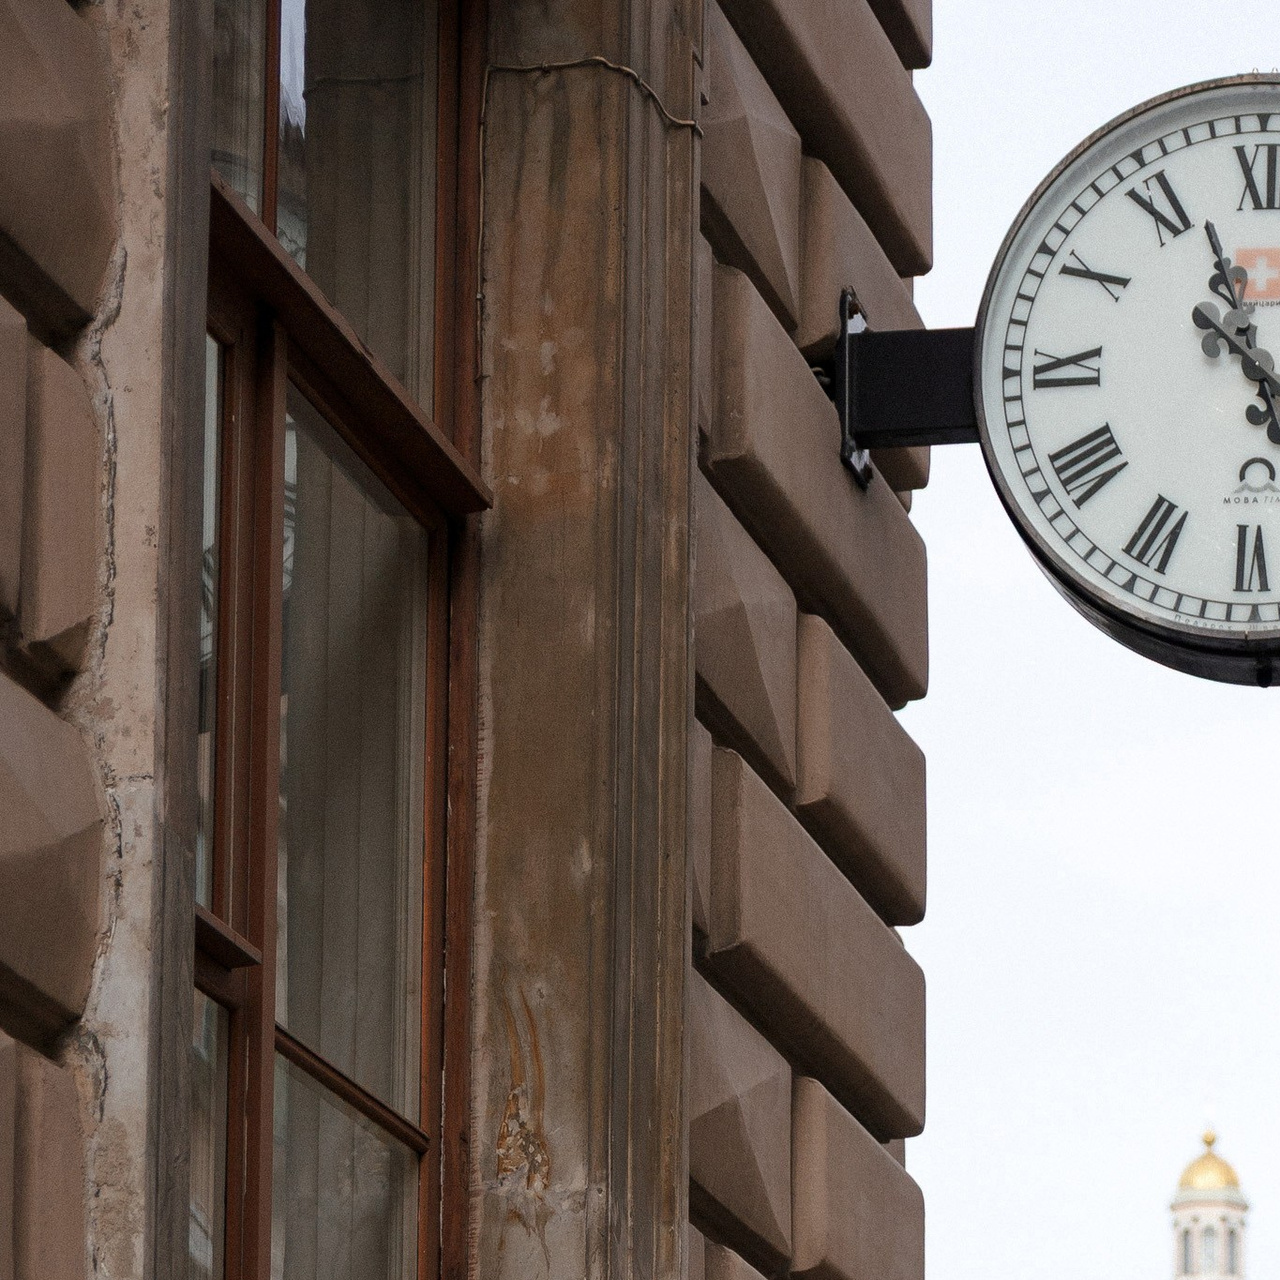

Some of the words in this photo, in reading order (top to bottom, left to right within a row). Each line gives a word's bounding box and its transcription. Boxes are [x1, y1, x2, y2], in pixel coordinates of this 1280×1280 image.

[1124, 169, 1195, 247] XI
[1059, 249, 1131, 303] X
[1033, 346, 1103, 390] IX
[1048, 422, 1129, 510] VIII
[1121, 493, 1189, 575] VII
[1233, 524, 1271, 592] VI
